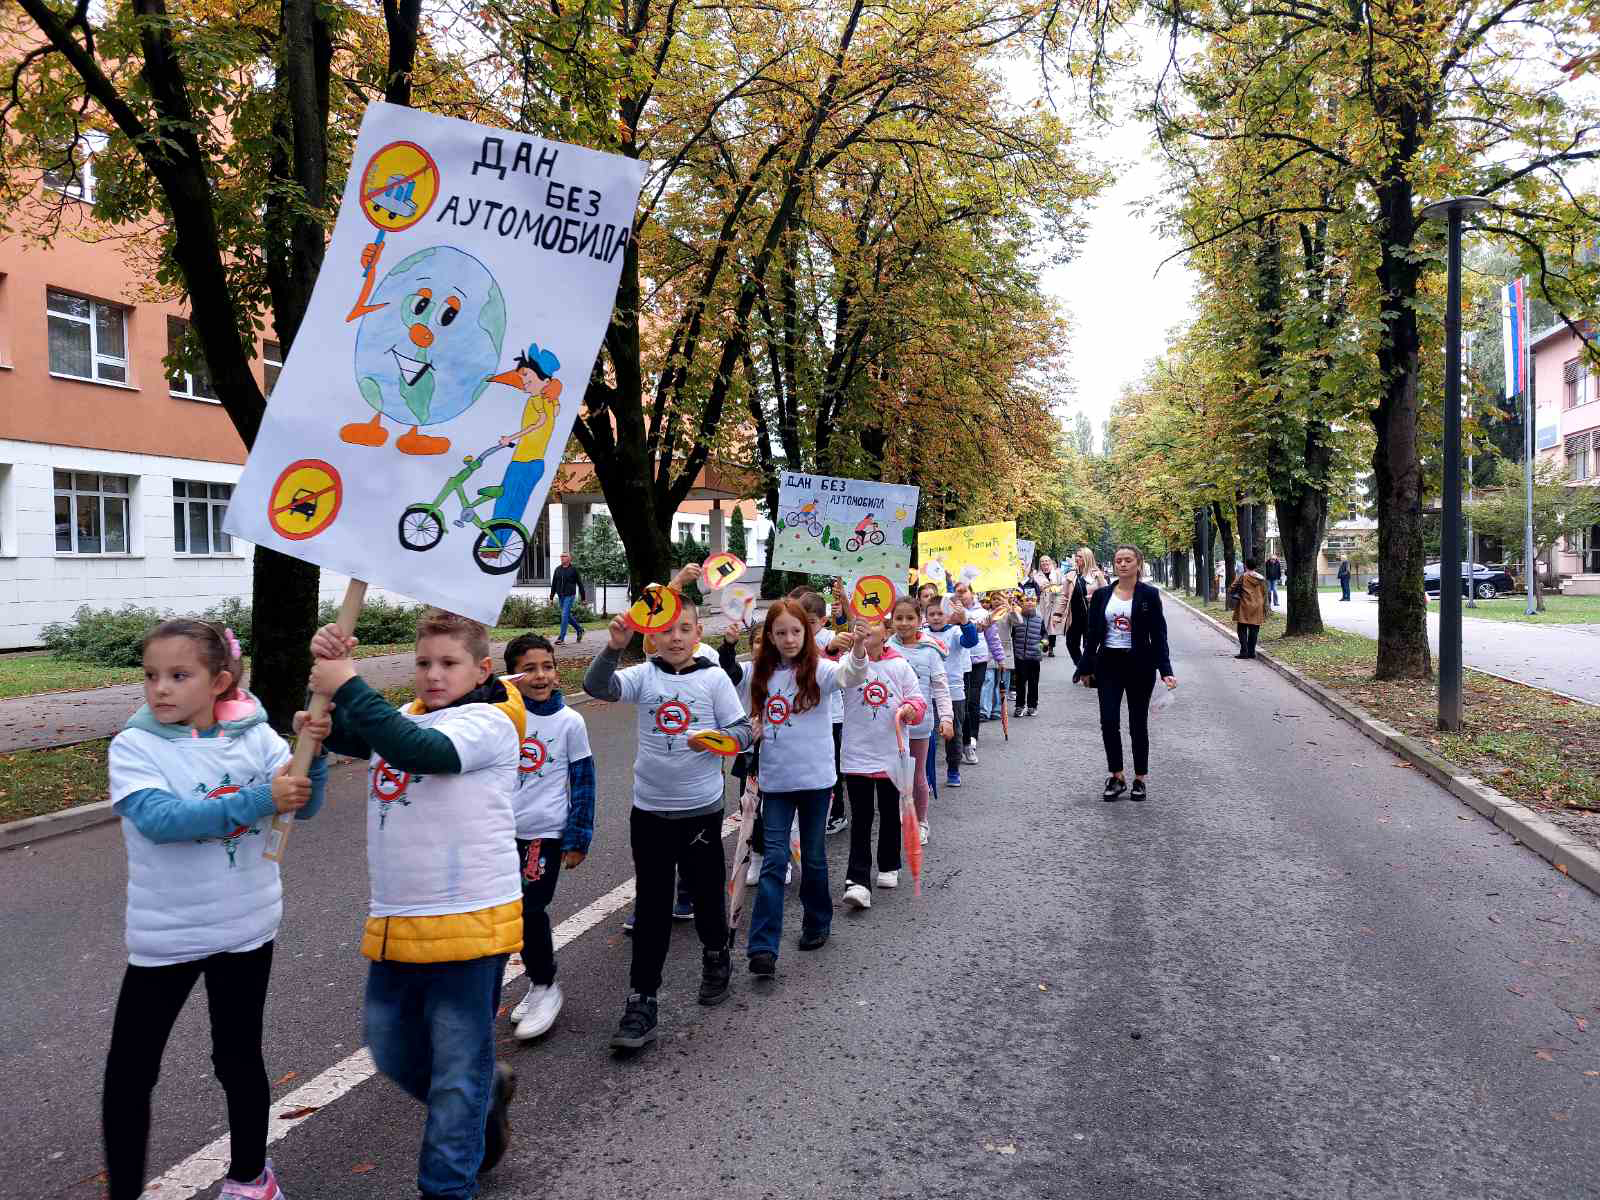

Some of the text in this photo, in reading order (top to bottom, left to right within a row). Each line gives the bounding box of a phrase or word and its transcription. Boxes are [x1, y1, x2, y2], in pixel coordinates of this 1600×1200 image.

[472, 136, 559, 180] ДАН
[545, 180, 602, 217] БЕЗ
[436, 195, 630, 263] АУТОМОБИЛА
[785, 475, 847, 492] ДАН БЕЗ
[831, 494, 885, 509] АУТОМОБИЛА
